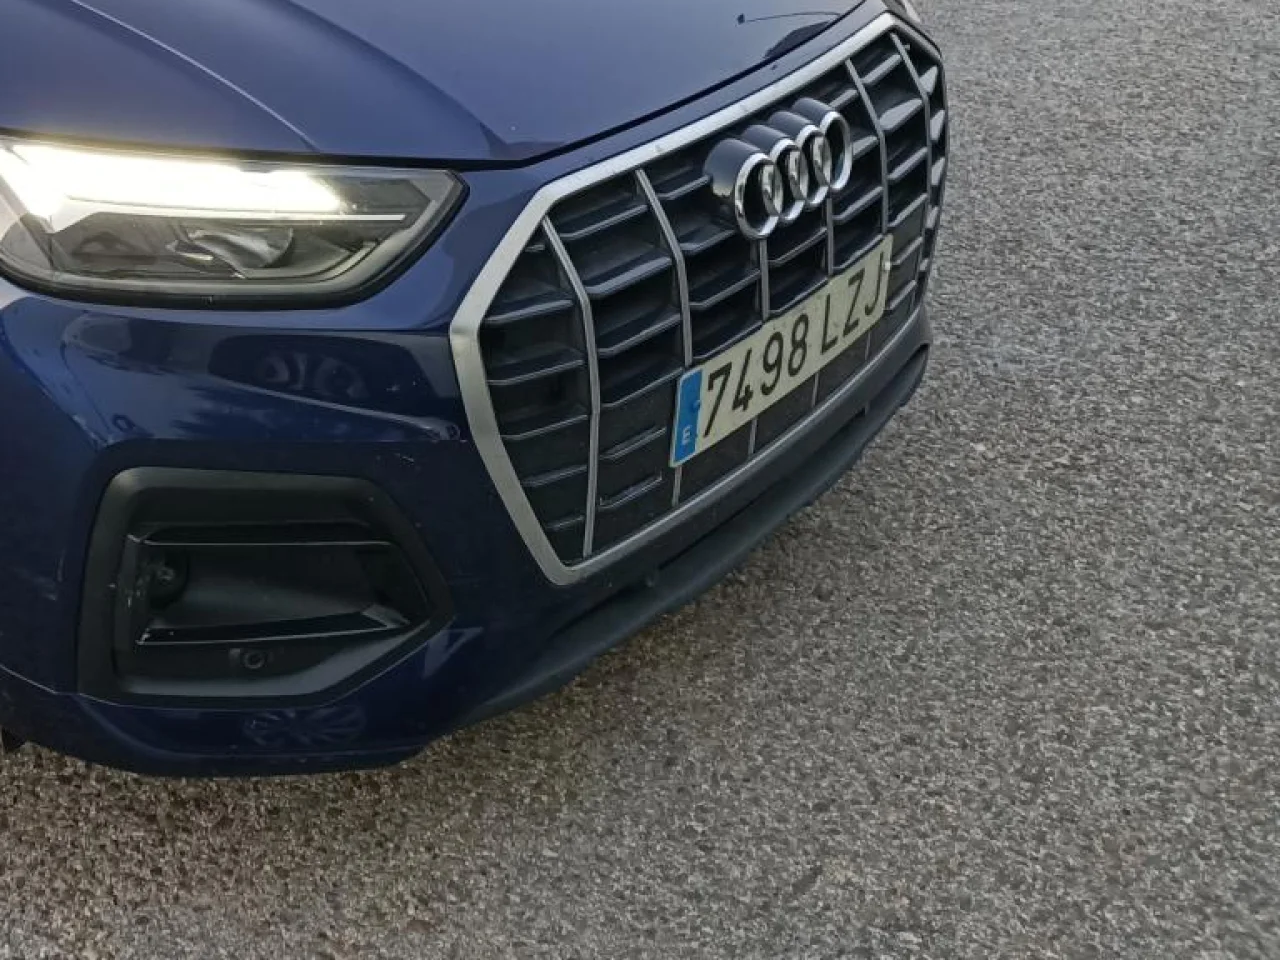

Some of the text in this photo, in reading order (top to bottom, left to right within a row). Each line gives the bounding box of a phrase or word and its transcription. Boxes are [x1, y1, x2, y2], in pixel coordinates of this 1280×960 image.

[703, 251, 884, 438] 7498 LZJ
[681, 426, 691, 444] E
